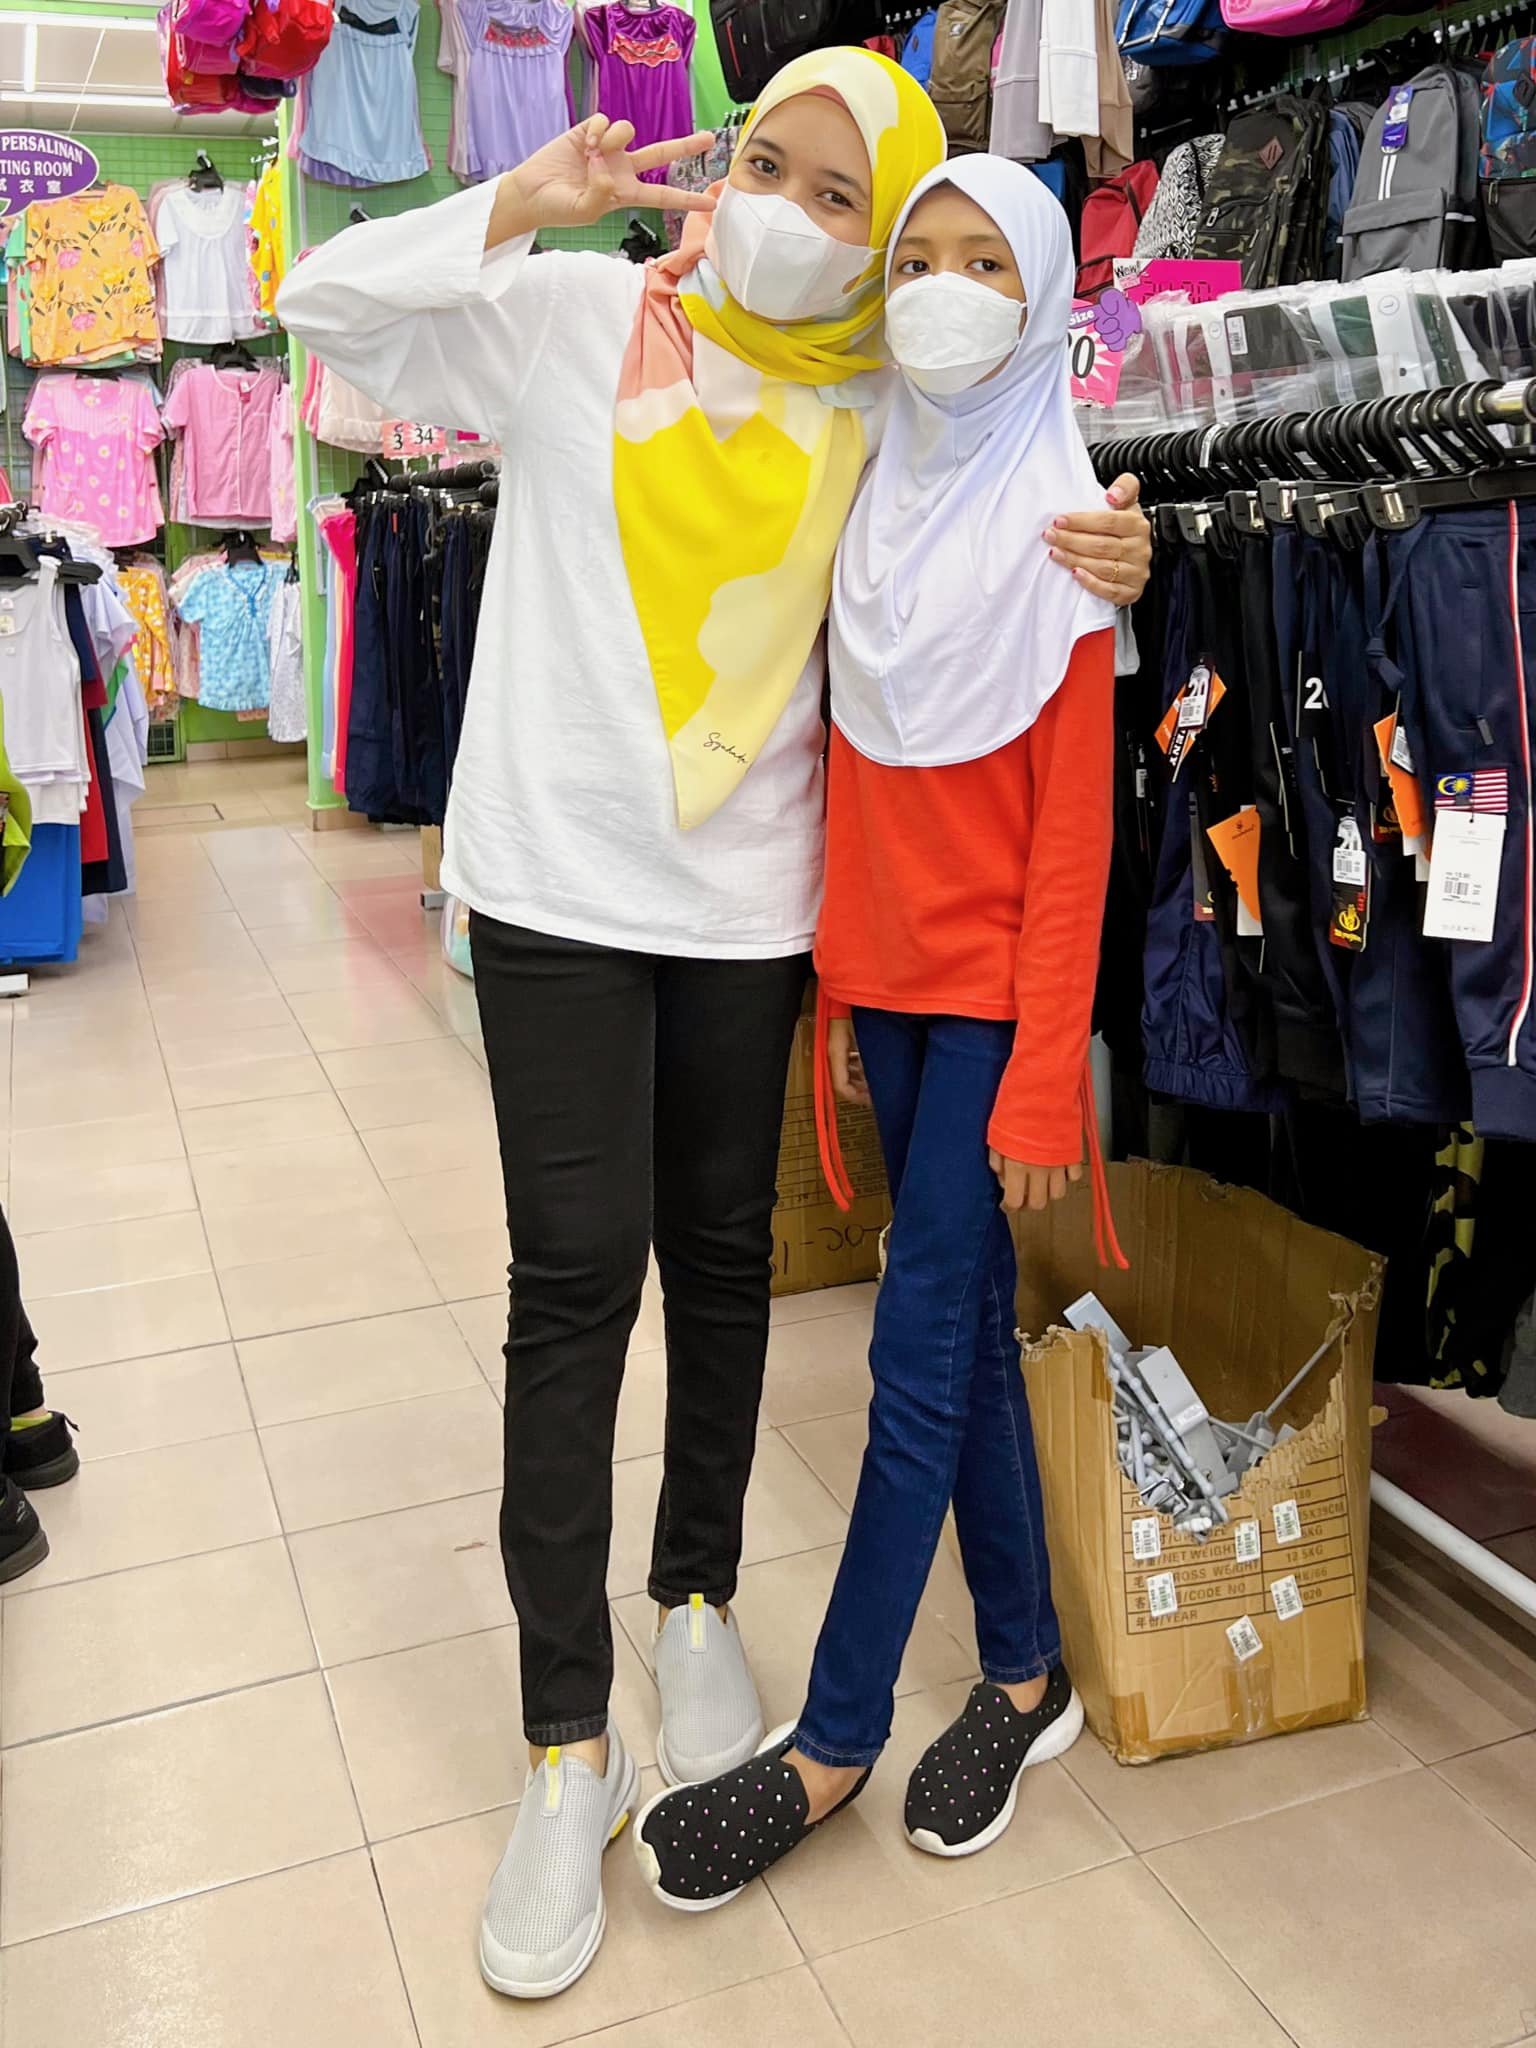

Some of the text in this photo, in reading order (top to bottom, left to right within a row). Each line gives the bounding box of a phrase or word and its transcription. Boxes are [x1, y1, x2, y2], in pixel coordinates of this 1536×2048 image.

[1, 135, 83, 165] PERSALINAN
[33, 161, 72, 177] ROOM
[1067, 332, 1096, 379] 0
[1174, 1568, 1207, 1582] ROSS
